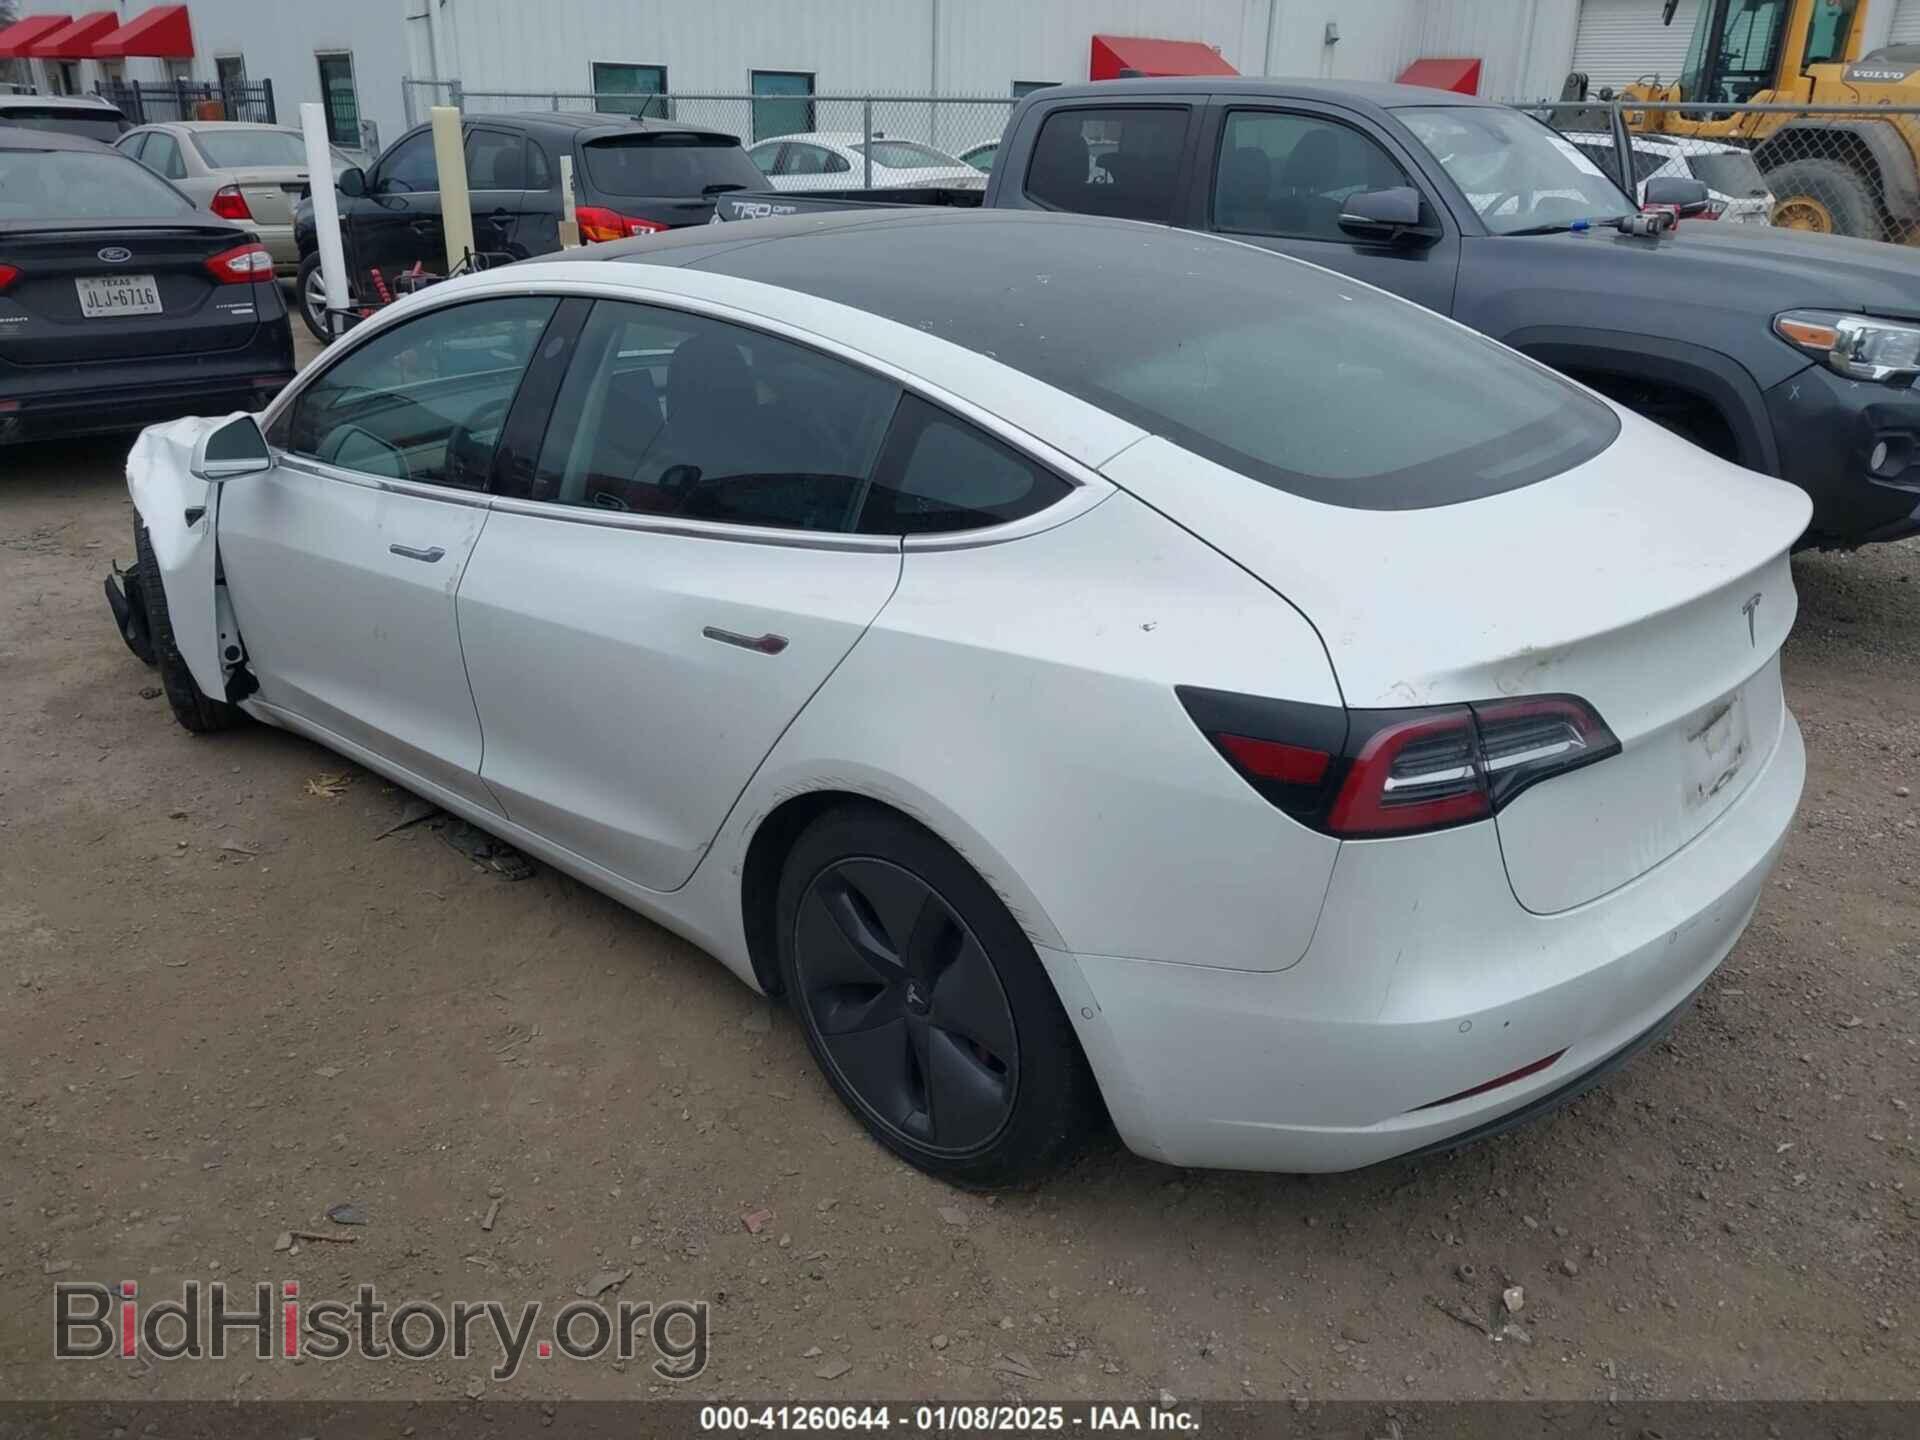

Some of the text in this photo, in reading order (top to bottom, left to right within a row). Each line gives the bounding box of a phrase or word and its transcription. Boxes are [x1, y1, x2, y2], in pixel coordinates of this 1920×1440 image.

[1853, 70, 1904, 79] VOLVO
[731, 202, 771, 218] TRD
[102, 279, 131, 287] TEXAS
